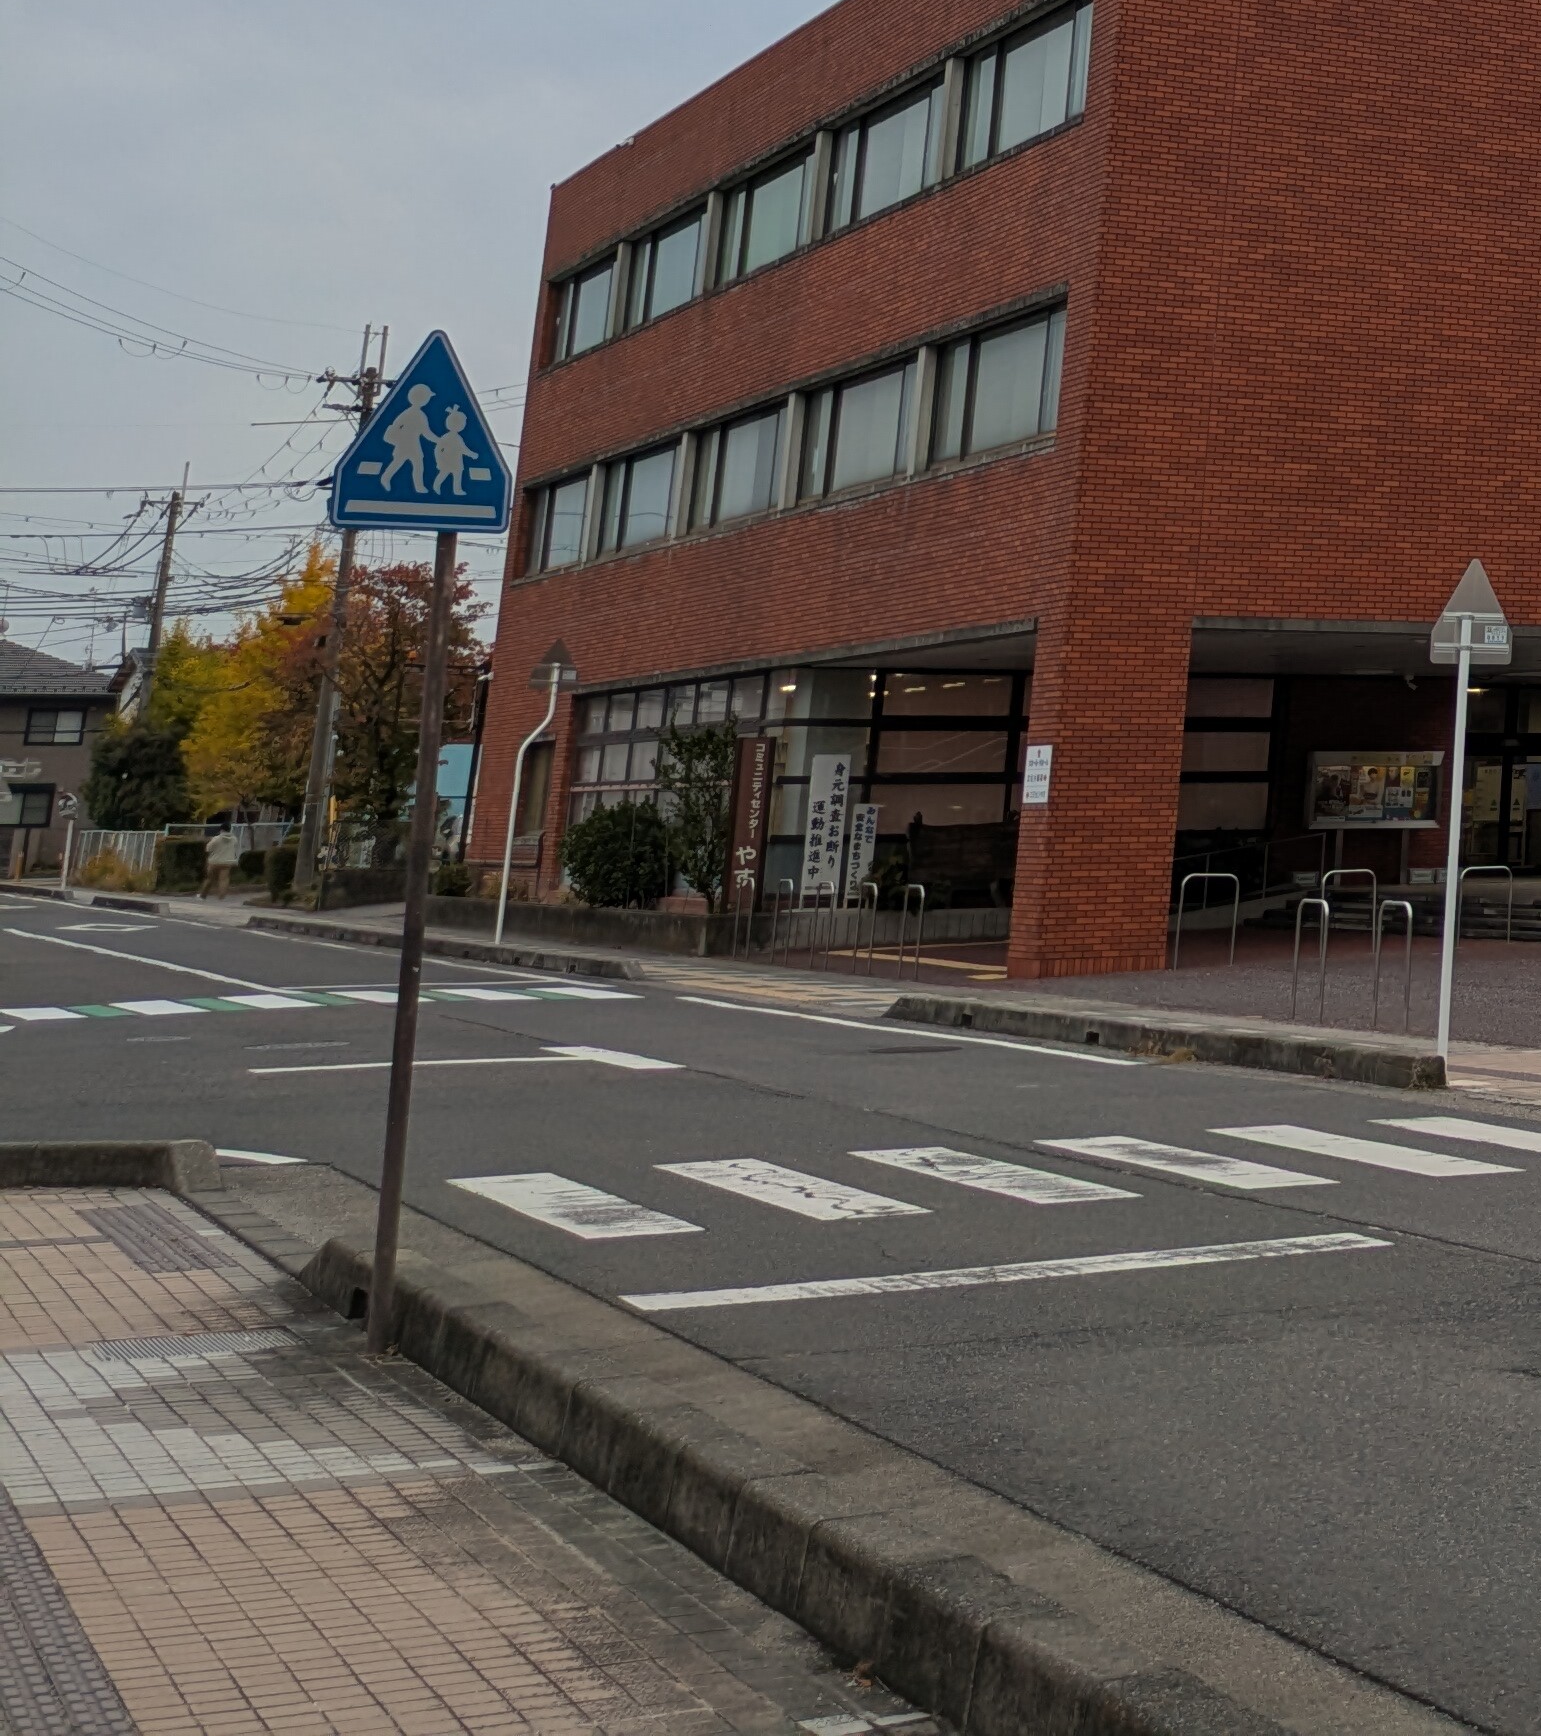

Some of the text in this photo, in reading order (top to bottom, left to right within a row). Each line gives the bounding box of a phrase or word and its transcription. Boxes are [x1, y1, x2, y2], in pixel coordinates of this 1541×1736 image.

[733, 743, 766, 889] コミュニティセンター やす
[807, 800, 826, 880] 運動推進中
[825, 761, 846, 869] 身元調査お断り
